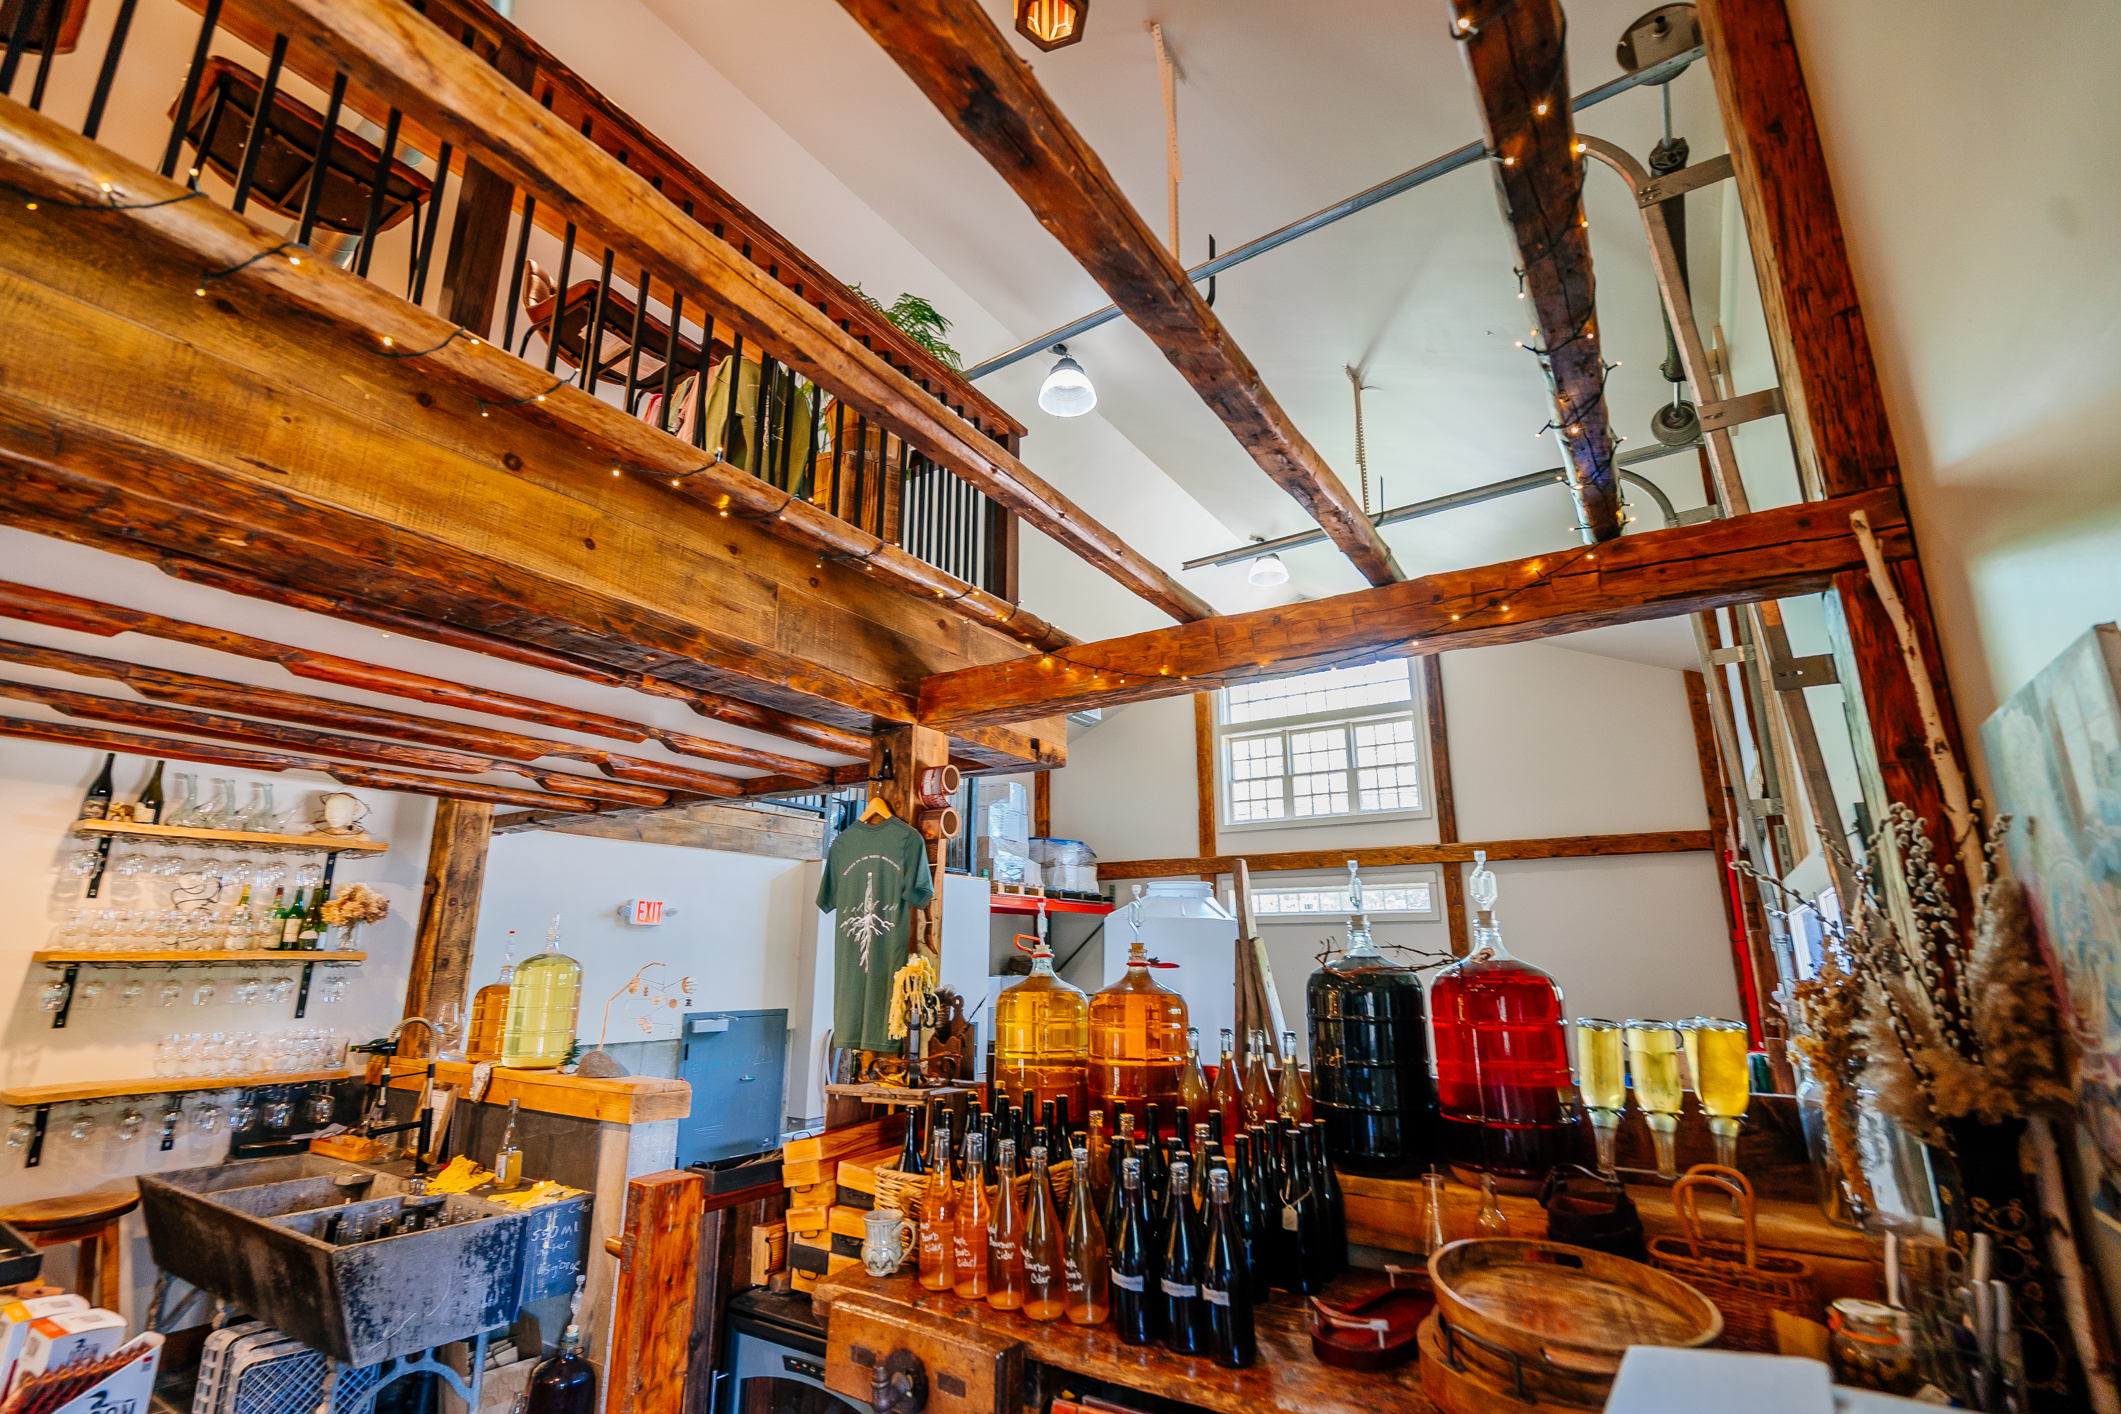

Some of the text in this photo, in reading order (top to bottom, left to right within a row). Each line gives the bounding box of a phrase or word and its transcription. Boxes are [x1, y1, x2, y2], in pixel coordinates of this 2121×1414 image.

[636, 901, 664, 924] EXIT
[530, 1225, 559, 1242] 550
[1030, 1272, 1051, 1284] Cider
